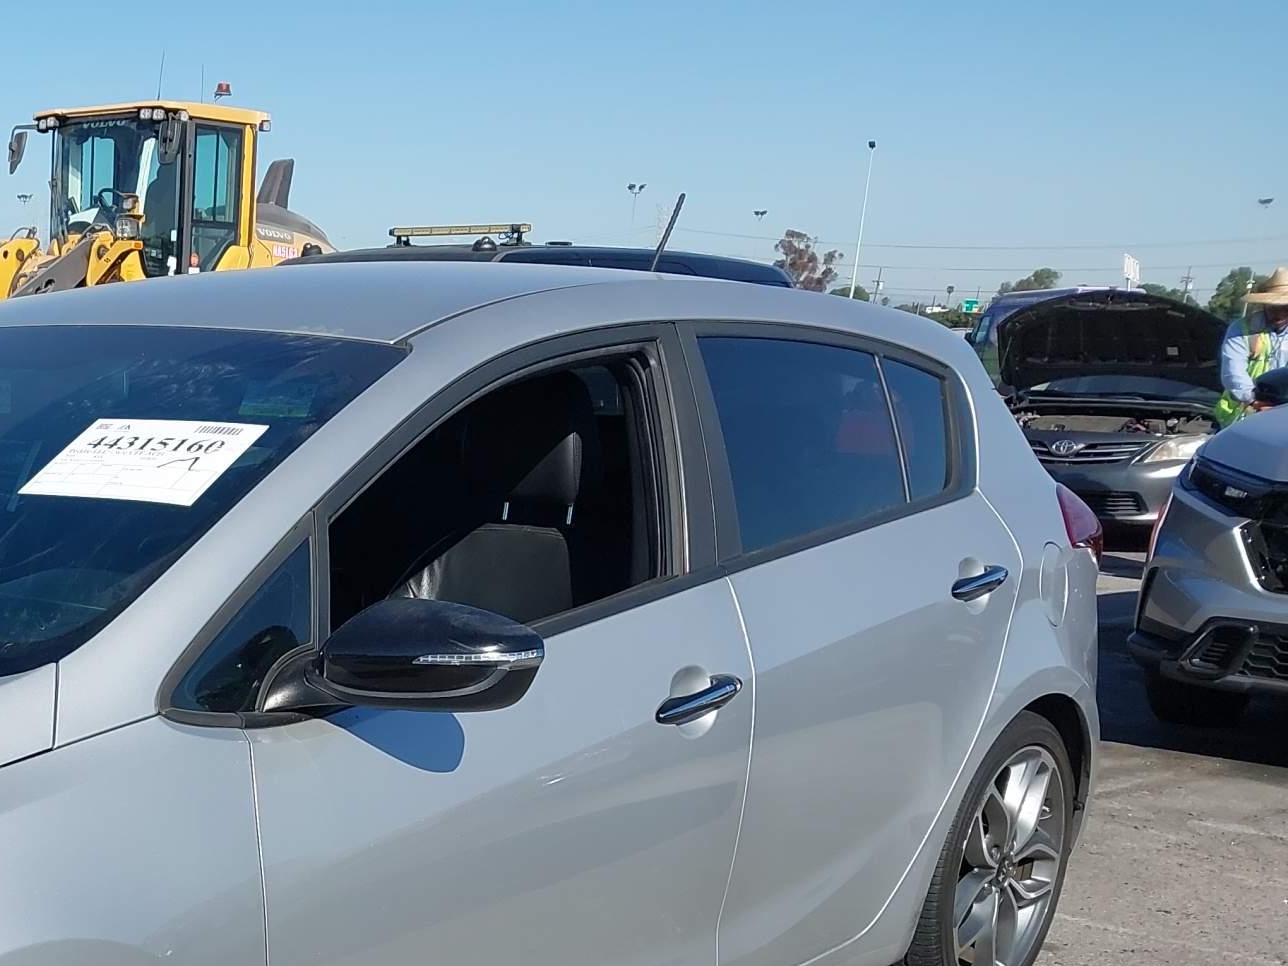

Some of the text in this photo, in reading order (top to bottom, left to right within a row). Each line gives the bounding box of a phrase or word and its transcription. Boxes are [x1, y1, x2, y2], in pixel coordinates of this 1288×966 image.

[82, 120, 126, 129] VOLVO
[257, 227, 292, 240] VOLVO
[88, 436, 226, 455] 44315160
